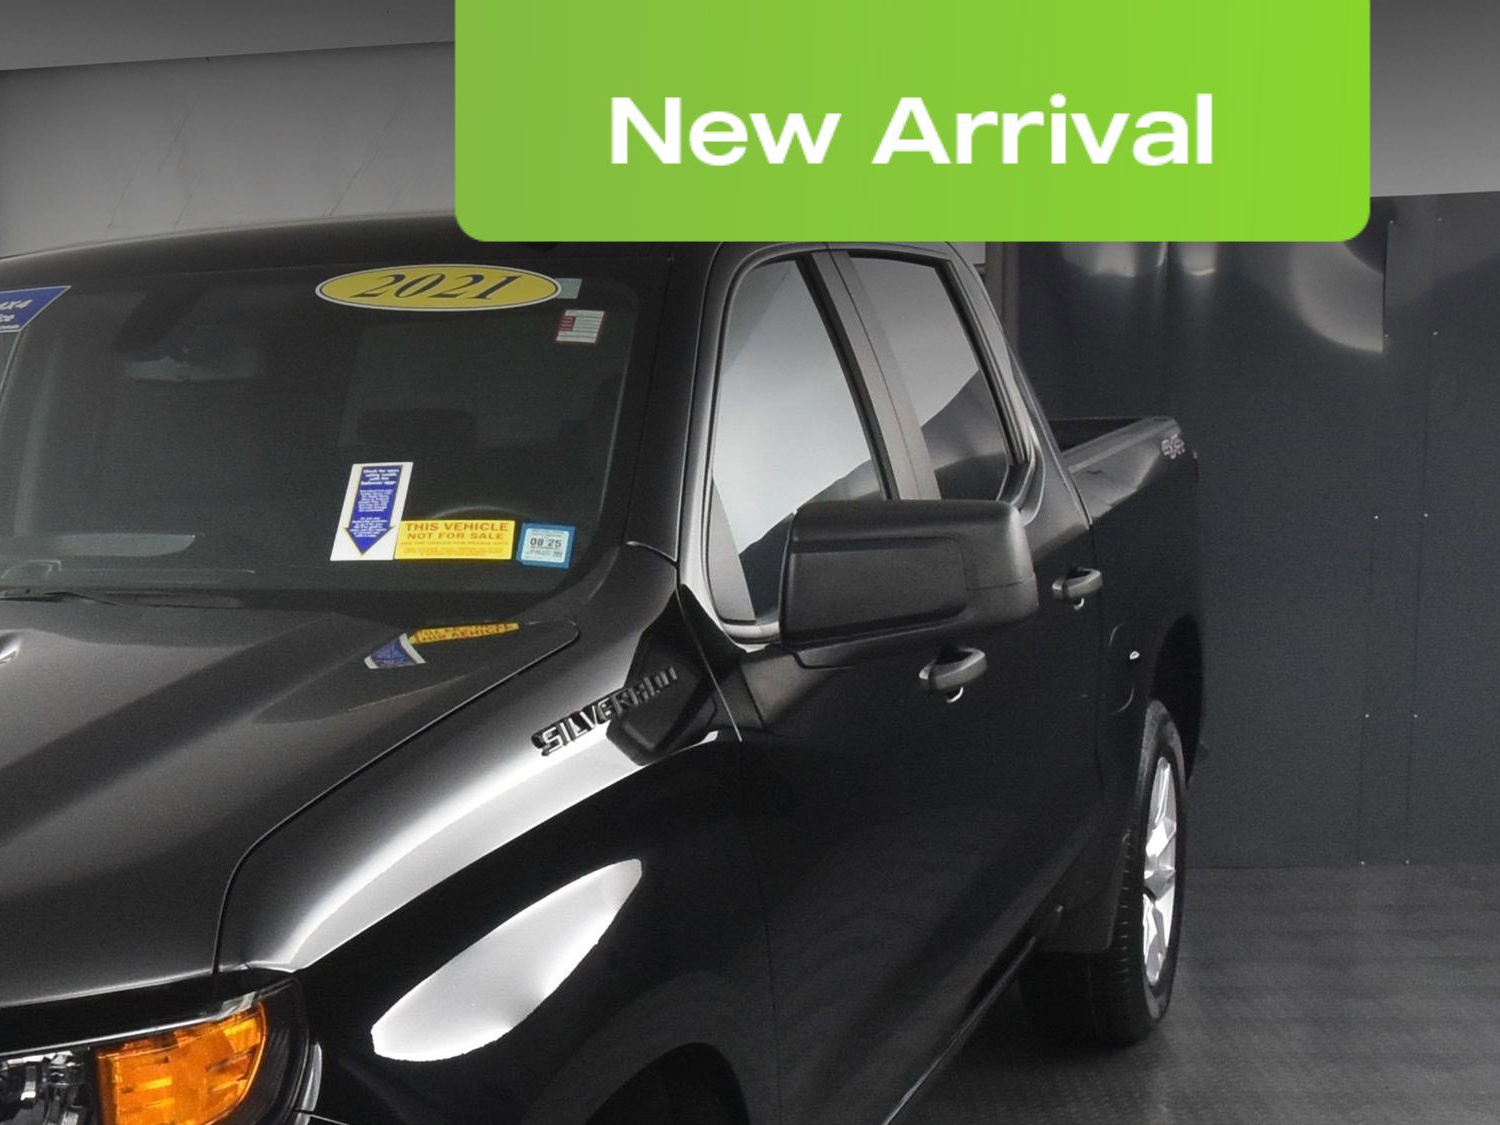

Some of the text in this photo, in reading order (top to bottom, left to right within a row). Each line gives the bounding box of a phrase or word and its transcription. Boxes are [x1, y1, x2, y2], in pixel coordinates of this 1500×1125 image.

[350, 272, 522, 300] 2021
[405, 522, 509, 532] THIS VEHICLE
[407, 532, 504, 540] NOT FOR SALE
